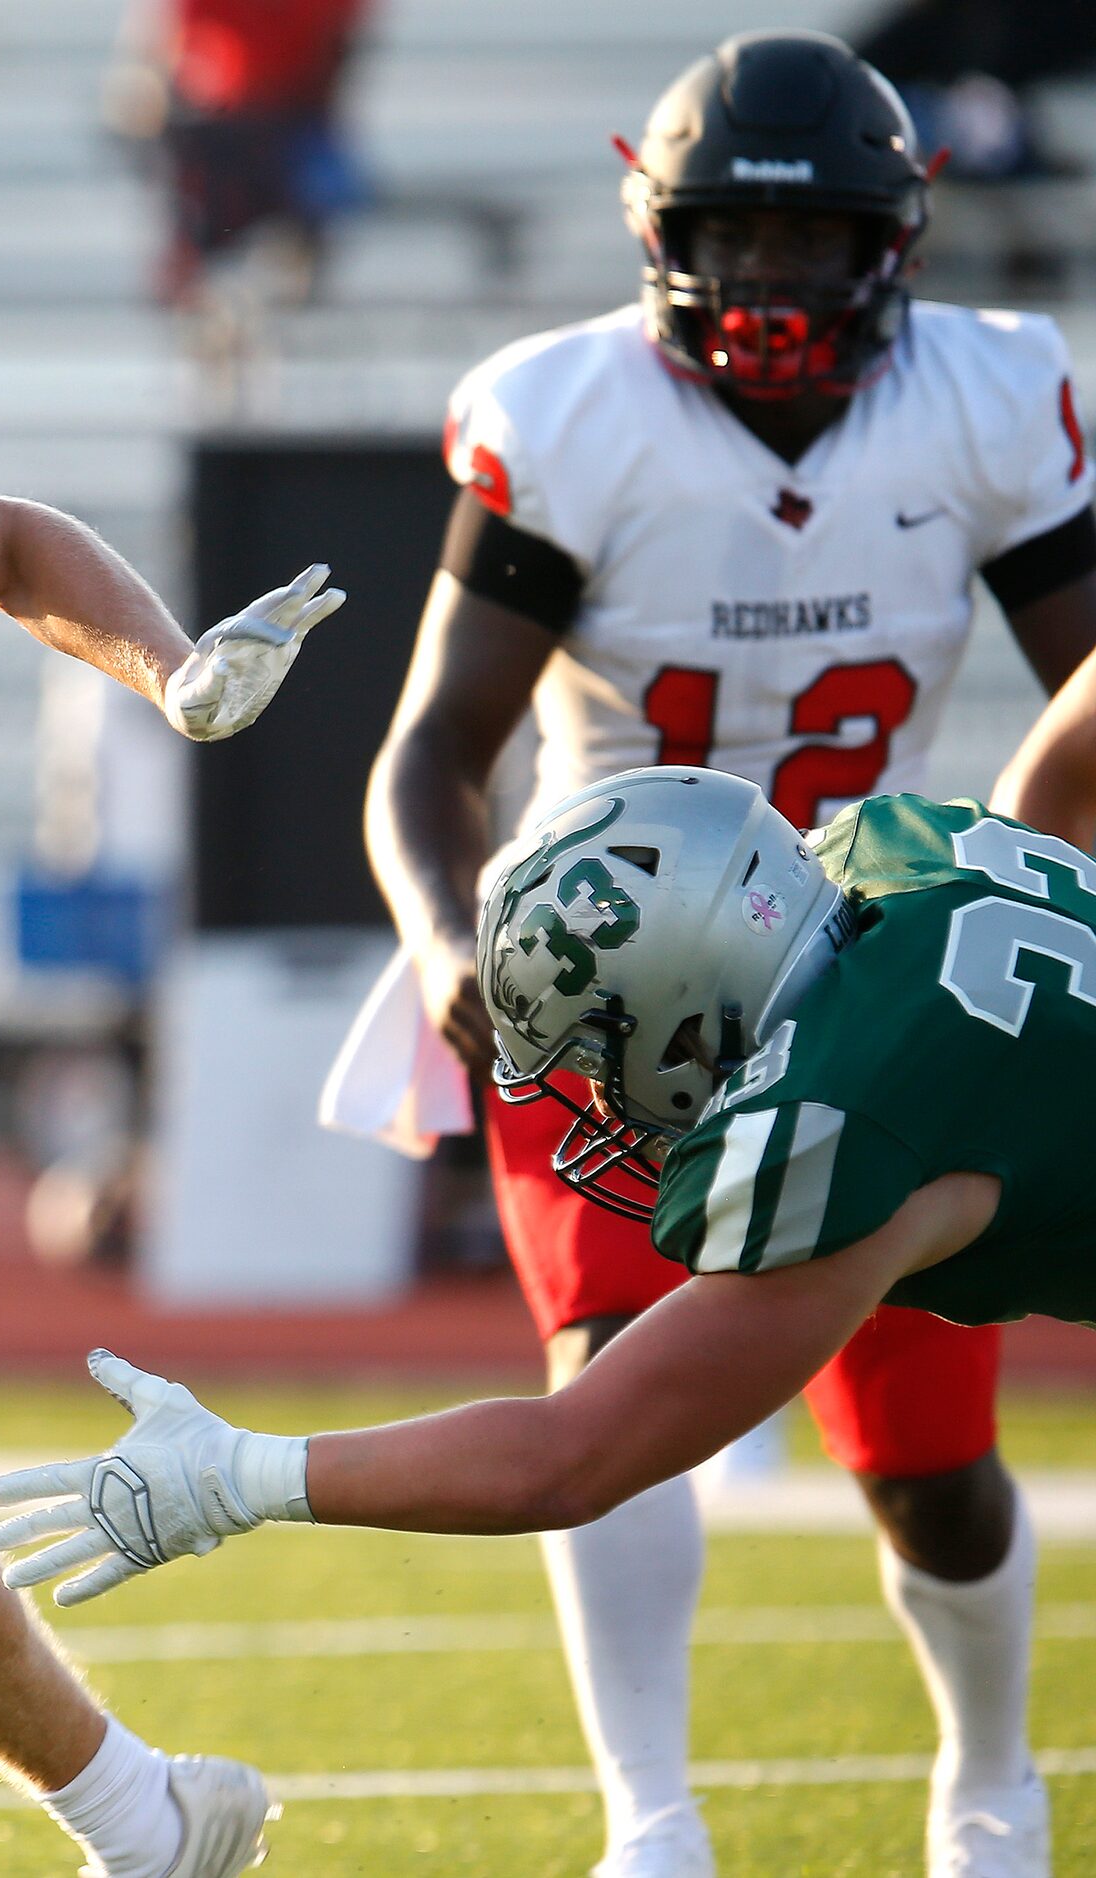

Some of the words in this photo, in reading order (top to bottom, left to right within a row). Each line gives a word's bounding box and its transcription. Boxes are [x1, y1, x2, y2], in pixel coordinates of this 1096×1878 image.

[711, 591, 873, 639] REDHAWKS
[643, 656, 918, 830] 12
[518, 858, 640, 996] 33
